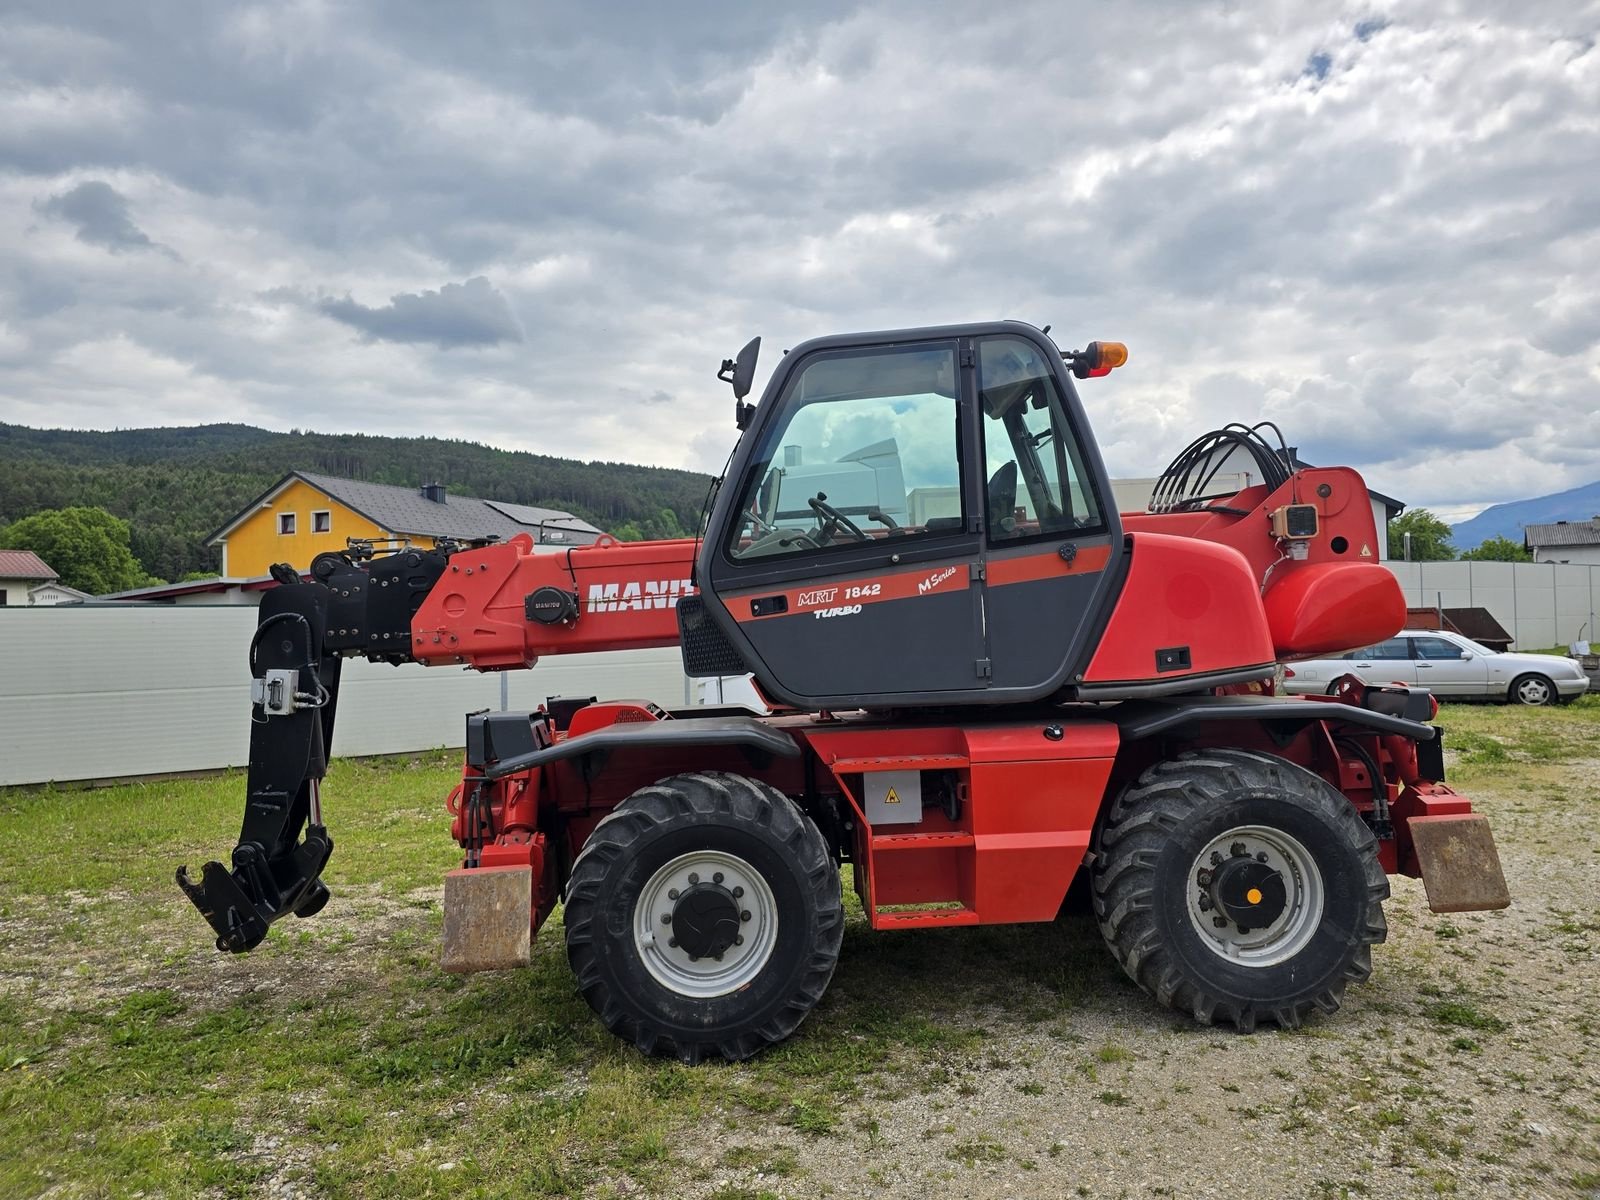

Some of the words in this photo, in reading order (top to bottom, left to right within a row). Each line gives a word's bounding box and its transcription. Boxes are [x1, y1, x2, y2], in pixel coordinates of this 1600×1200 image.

[918, 578, 932, 595] M
[930, 566, 957, 587] Series
[797, 587, 838, 606] MRT
[845, 583, 881, 599] 1842
[813, 604, 862, 619] TURBO
